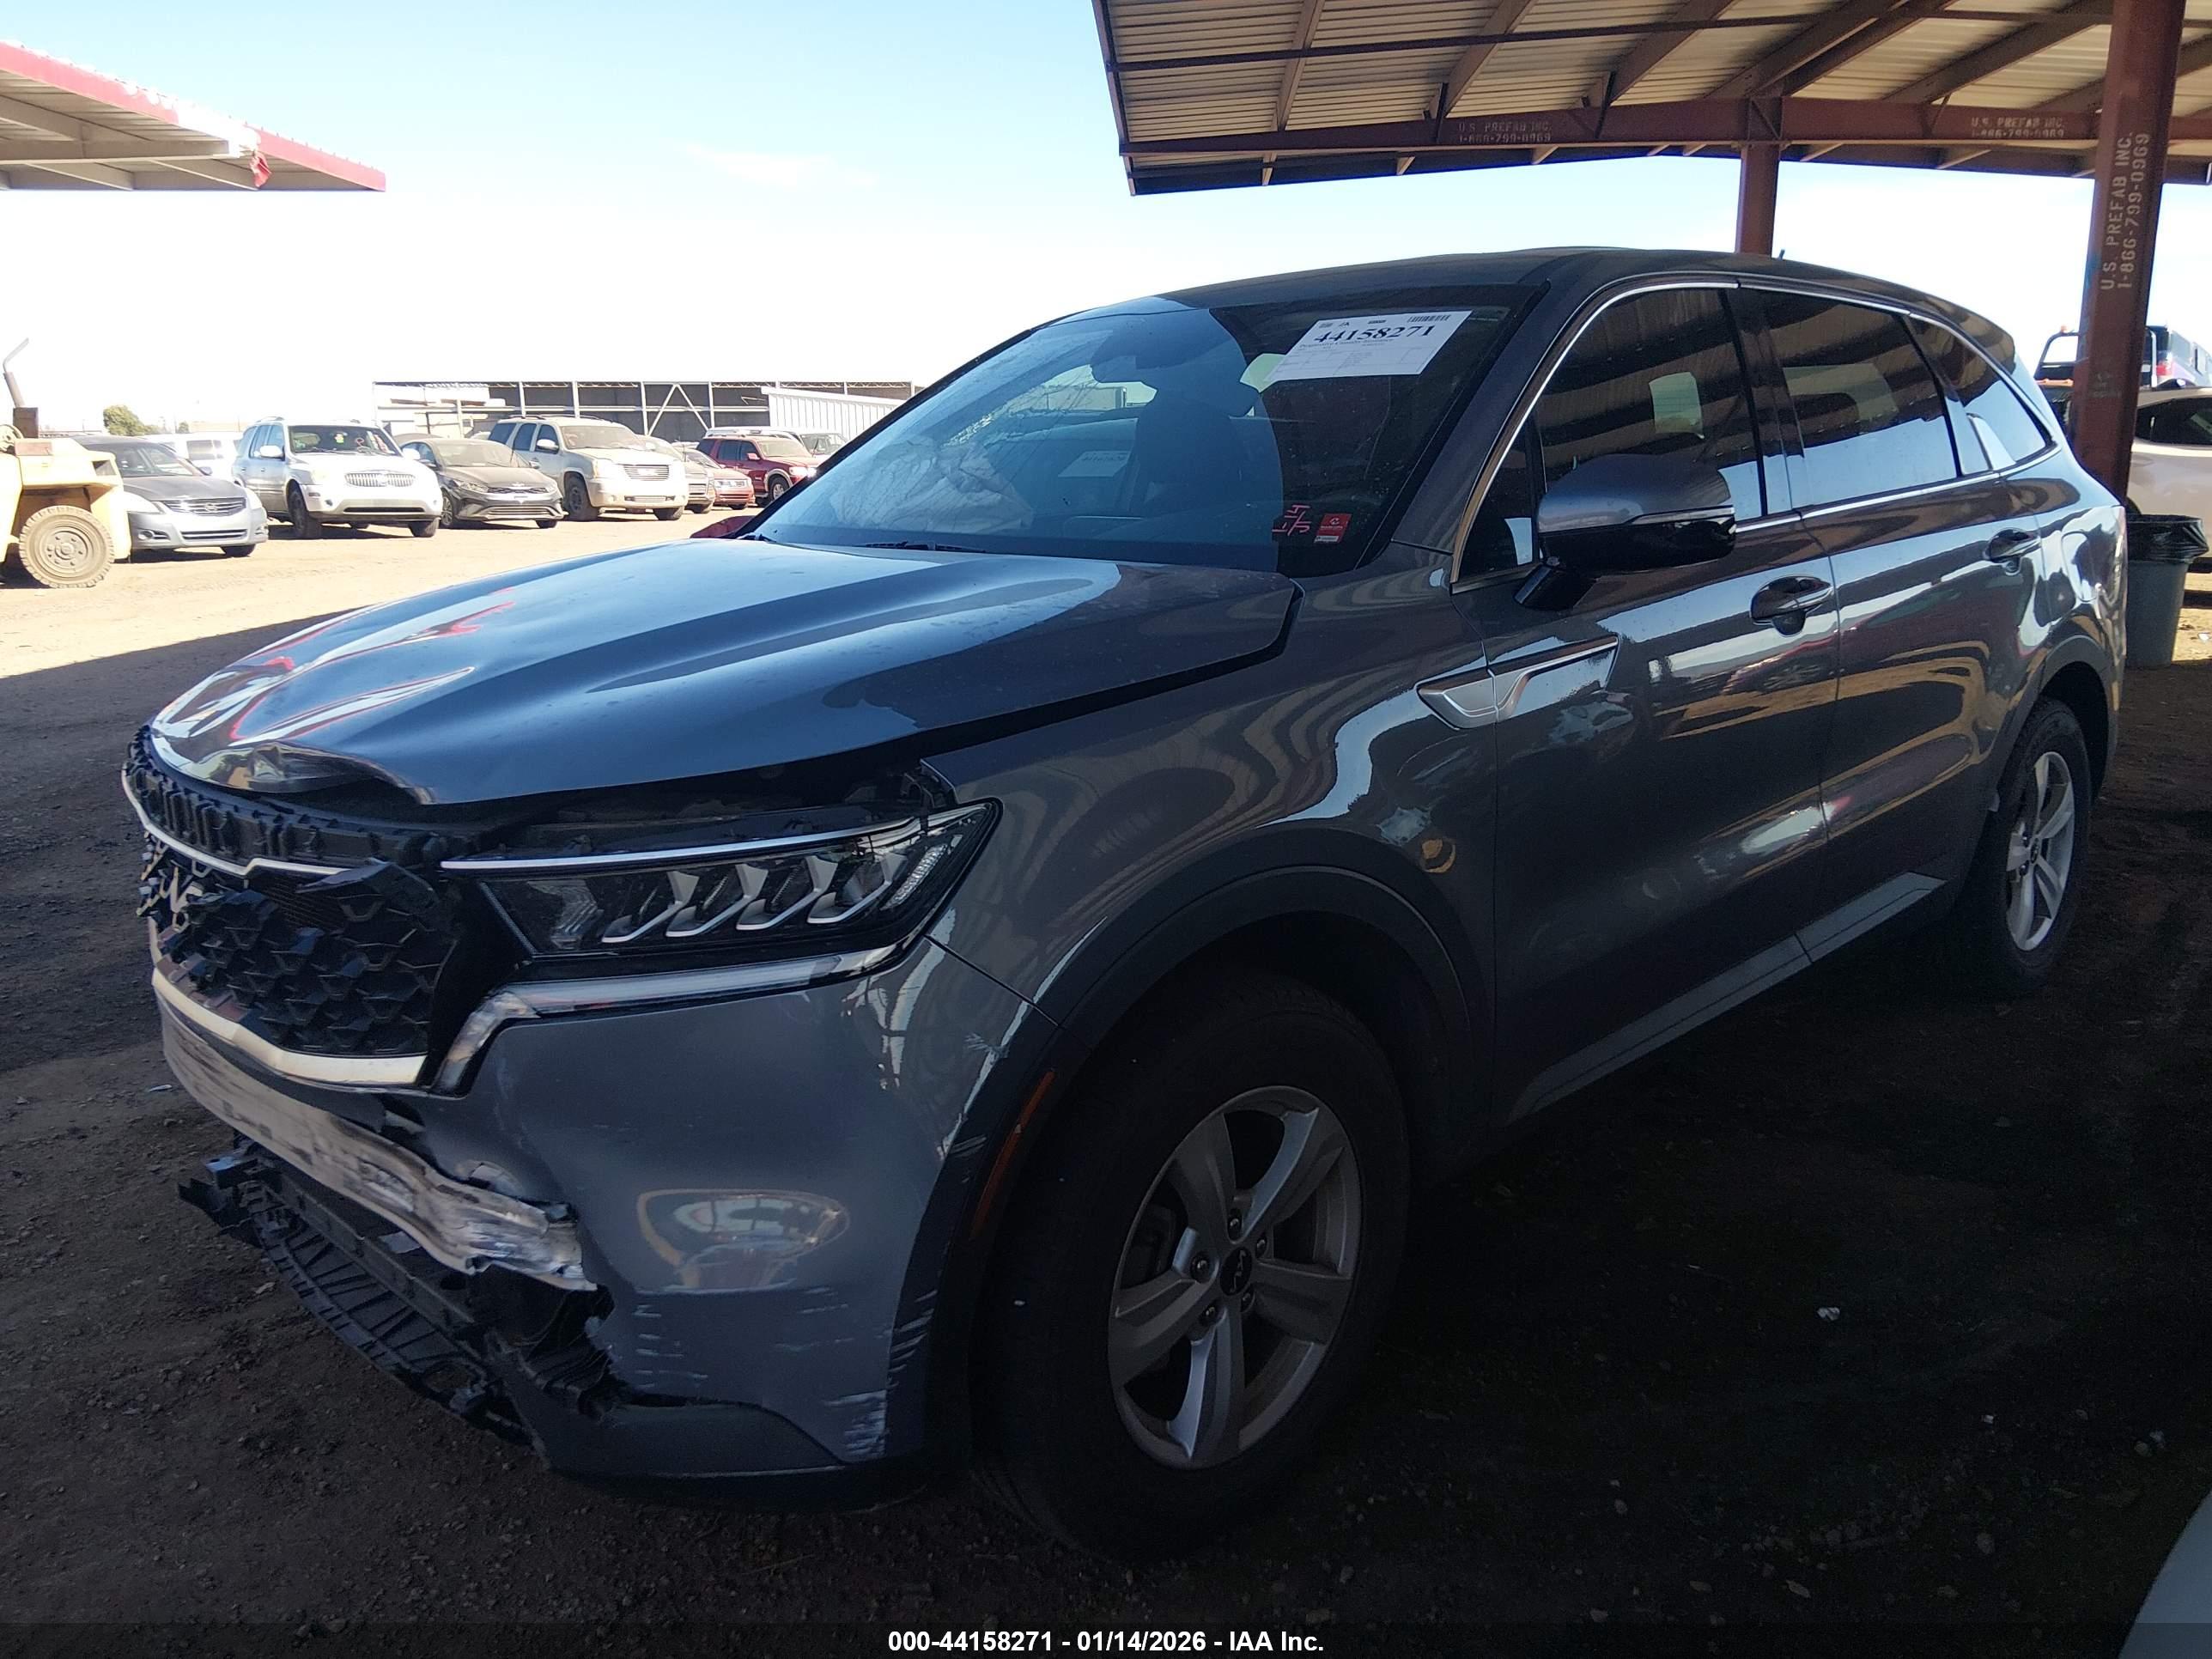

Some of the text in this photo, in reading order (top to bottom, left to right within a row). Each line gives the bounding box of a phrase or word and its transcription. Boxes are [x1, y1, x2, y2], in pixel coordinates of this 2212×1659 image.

[2115, 132, 2133, 167] INC.
[2106, 176, 2127, 246] PREFAB
[2118, 133, 2150, 289] 1-866-799-0969
[1314, 325, 1436, 343] 44158271
